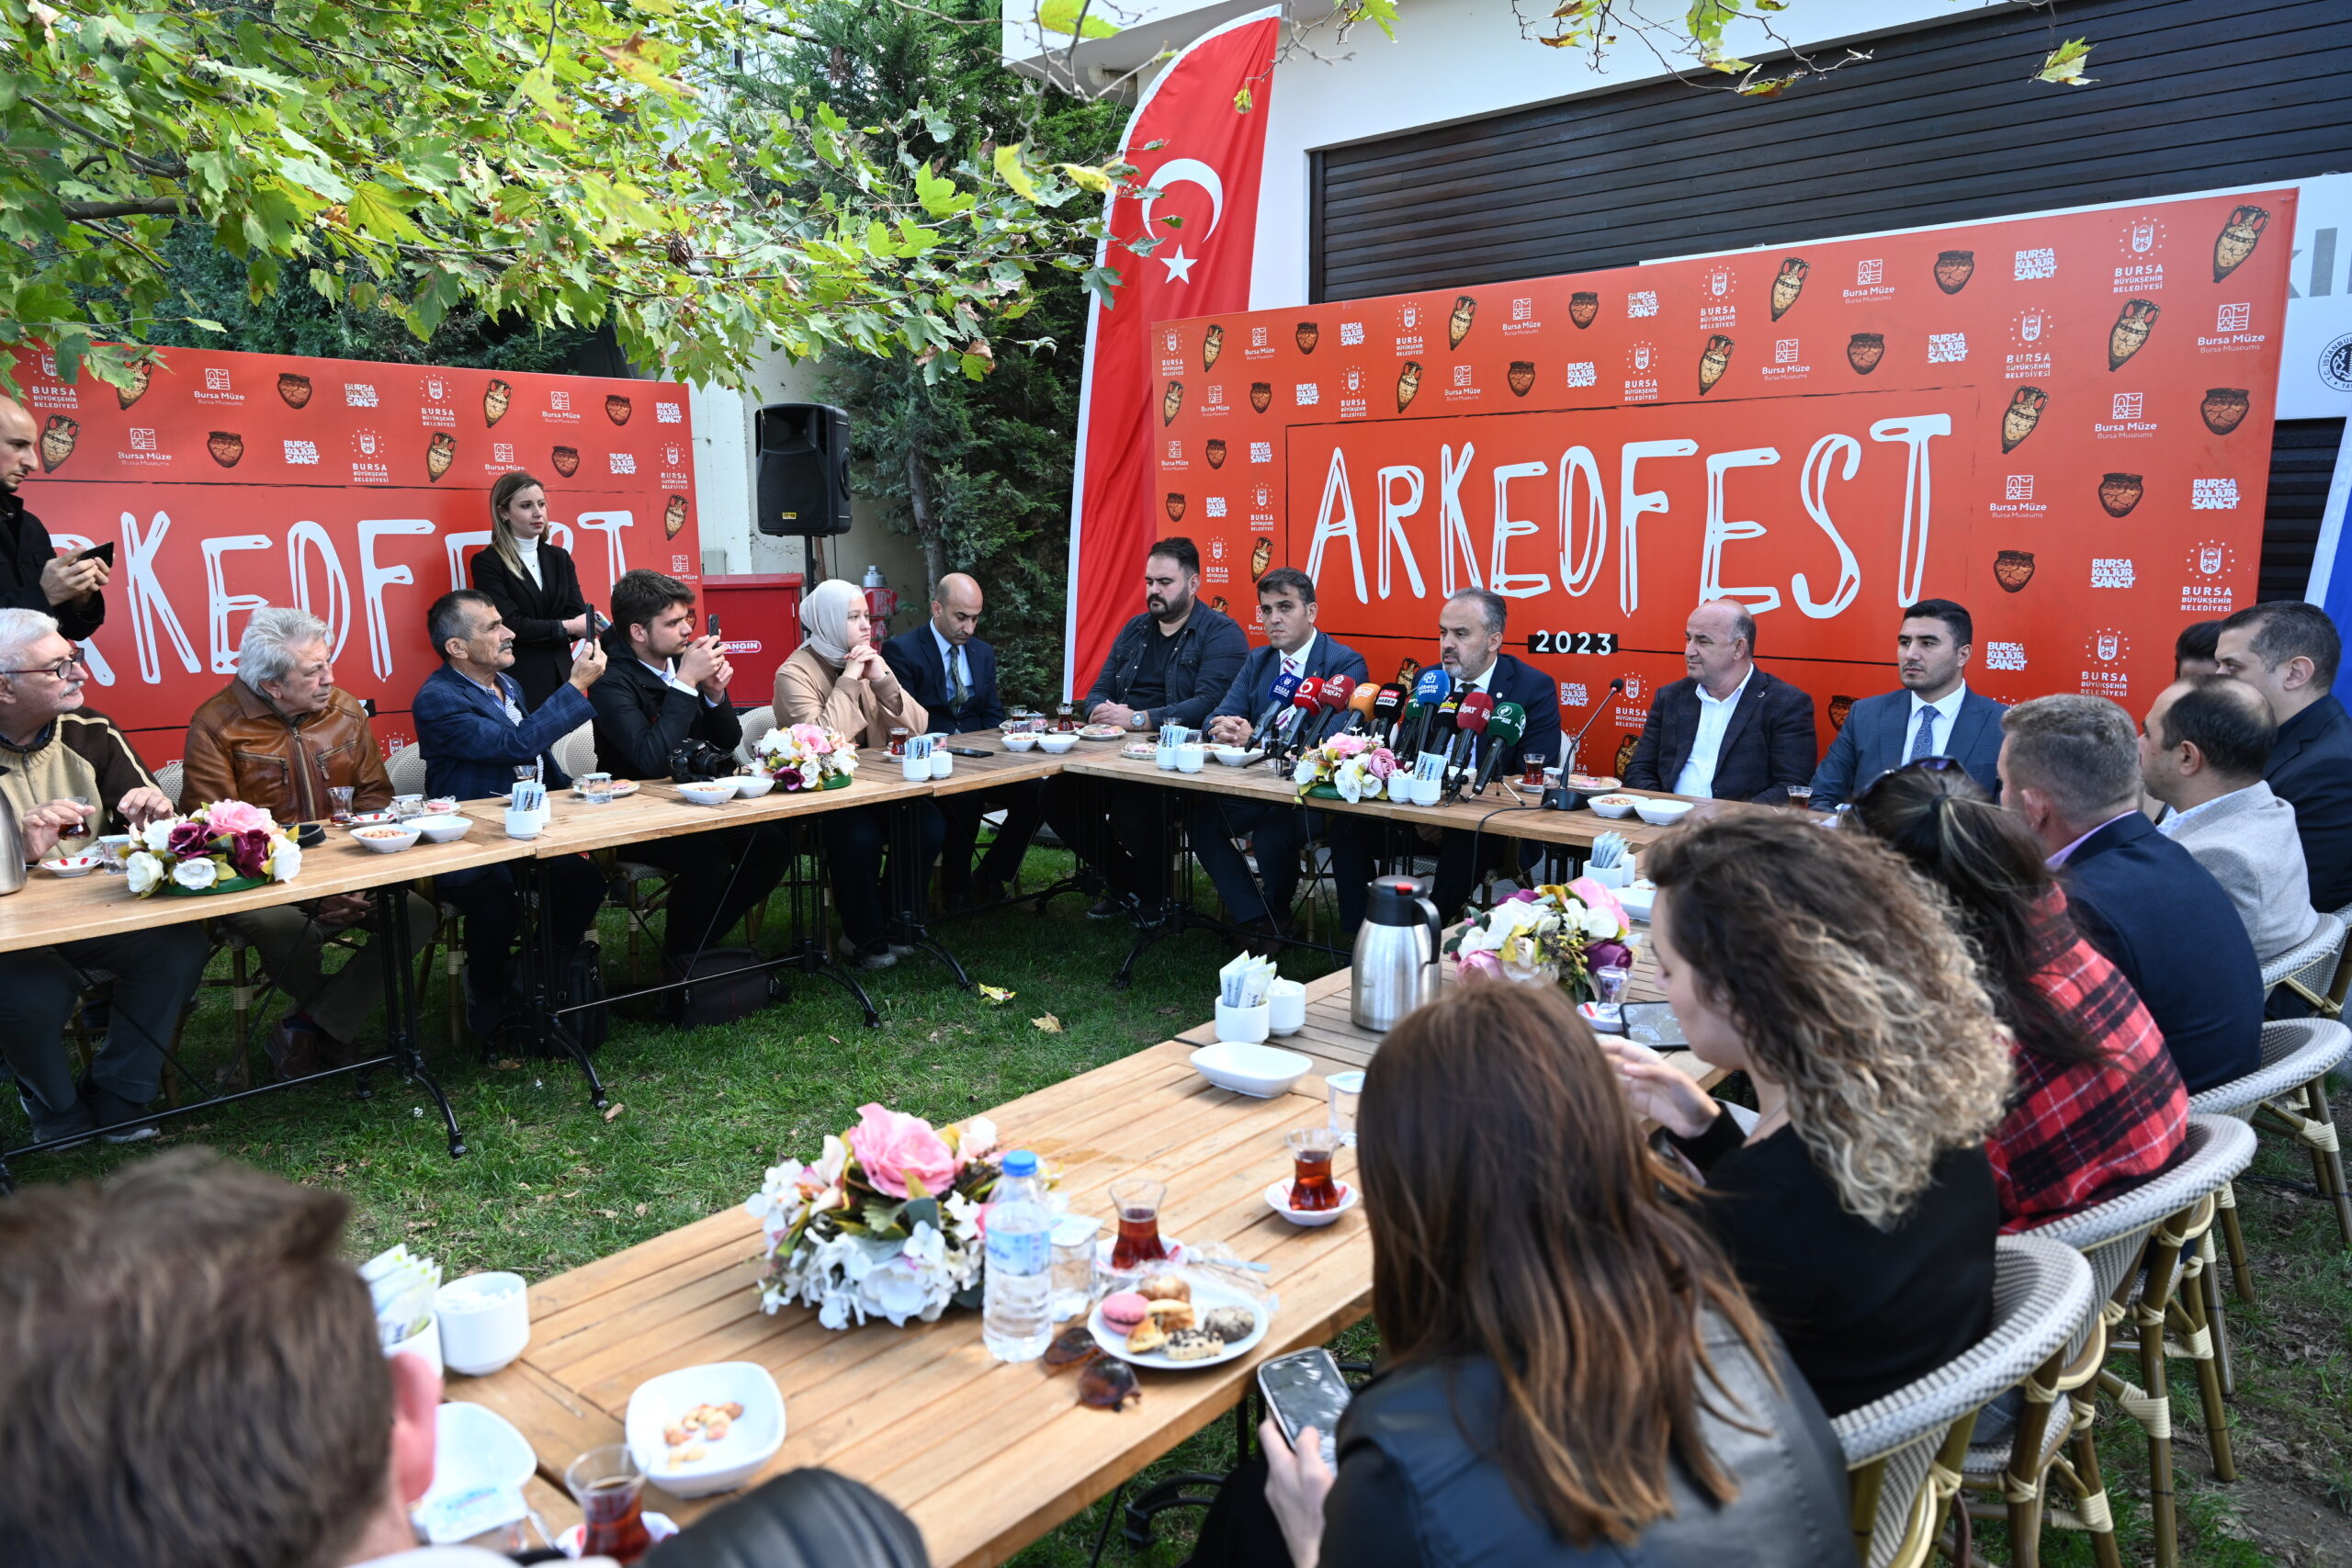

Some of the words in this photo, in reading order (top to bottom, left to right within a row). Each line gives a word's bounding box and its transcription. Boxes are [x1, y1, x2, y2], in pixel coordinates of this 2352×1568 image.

[2016, 247, 2054, 261] BURSA
[2115, 264, 2163, 277] BURSA
[1843, 288, 1867, 297] Bursa
[1870, 285, 1895, 295] Müze
[2114, 283, 2162, 293] BELEDİYESİ
[1628, 290, 1656, 301] BURSA
[1701, 305, 1735, 316] BURSA
[1341, 322, 1362, 331] BURSA
[1503, 322, 1521, 331] Bursa
[1700, 321, 1735, 329] BELEDİYESİ
[1396, 336, 1423, 345] BURSA
[1929, 333, 1965, 344] BURSA
[2198, 335, 2229, 346] Bursa
[2233, 333, 2265, 343] Müze
[2223, 343, 2260, 351] Museums
[2007, 352, 2051, 363] BURSA
[1568, 361, 1594, 371] BURSA
[1762, 366, 1785, 374] Bursa
[1787, 364, 1810, 373] Müze
[2006, 369, 2050, 379] BELEDİYESİ
[1625, 379, 1657, 388] BURSA
[32, 386, 76, 396] BURSA
[2095, 423, 2124, 432] Bursa
[2127, 421, 2157, 431] Müze
[284, 440, 315, 448] BURSA
[2193, 478, 2236, 488] BURSA
[1306, 412, 1951, 618] ARKEOFEST
[2092, 559, 2132, 568] BURSA
[2183, 586, 2232, 596] BURSA
[1536, 631, 1613, 655] 2023
[1987, 642, 2024, 652] BURSA
[2082, 671, 2127, 682] BURSA
[1561, 682, 1586, 691] BURSA
[2081, 688, 2127, 696] BELEDİYESİ
[1616, 707, 1647, 716] BURSA
